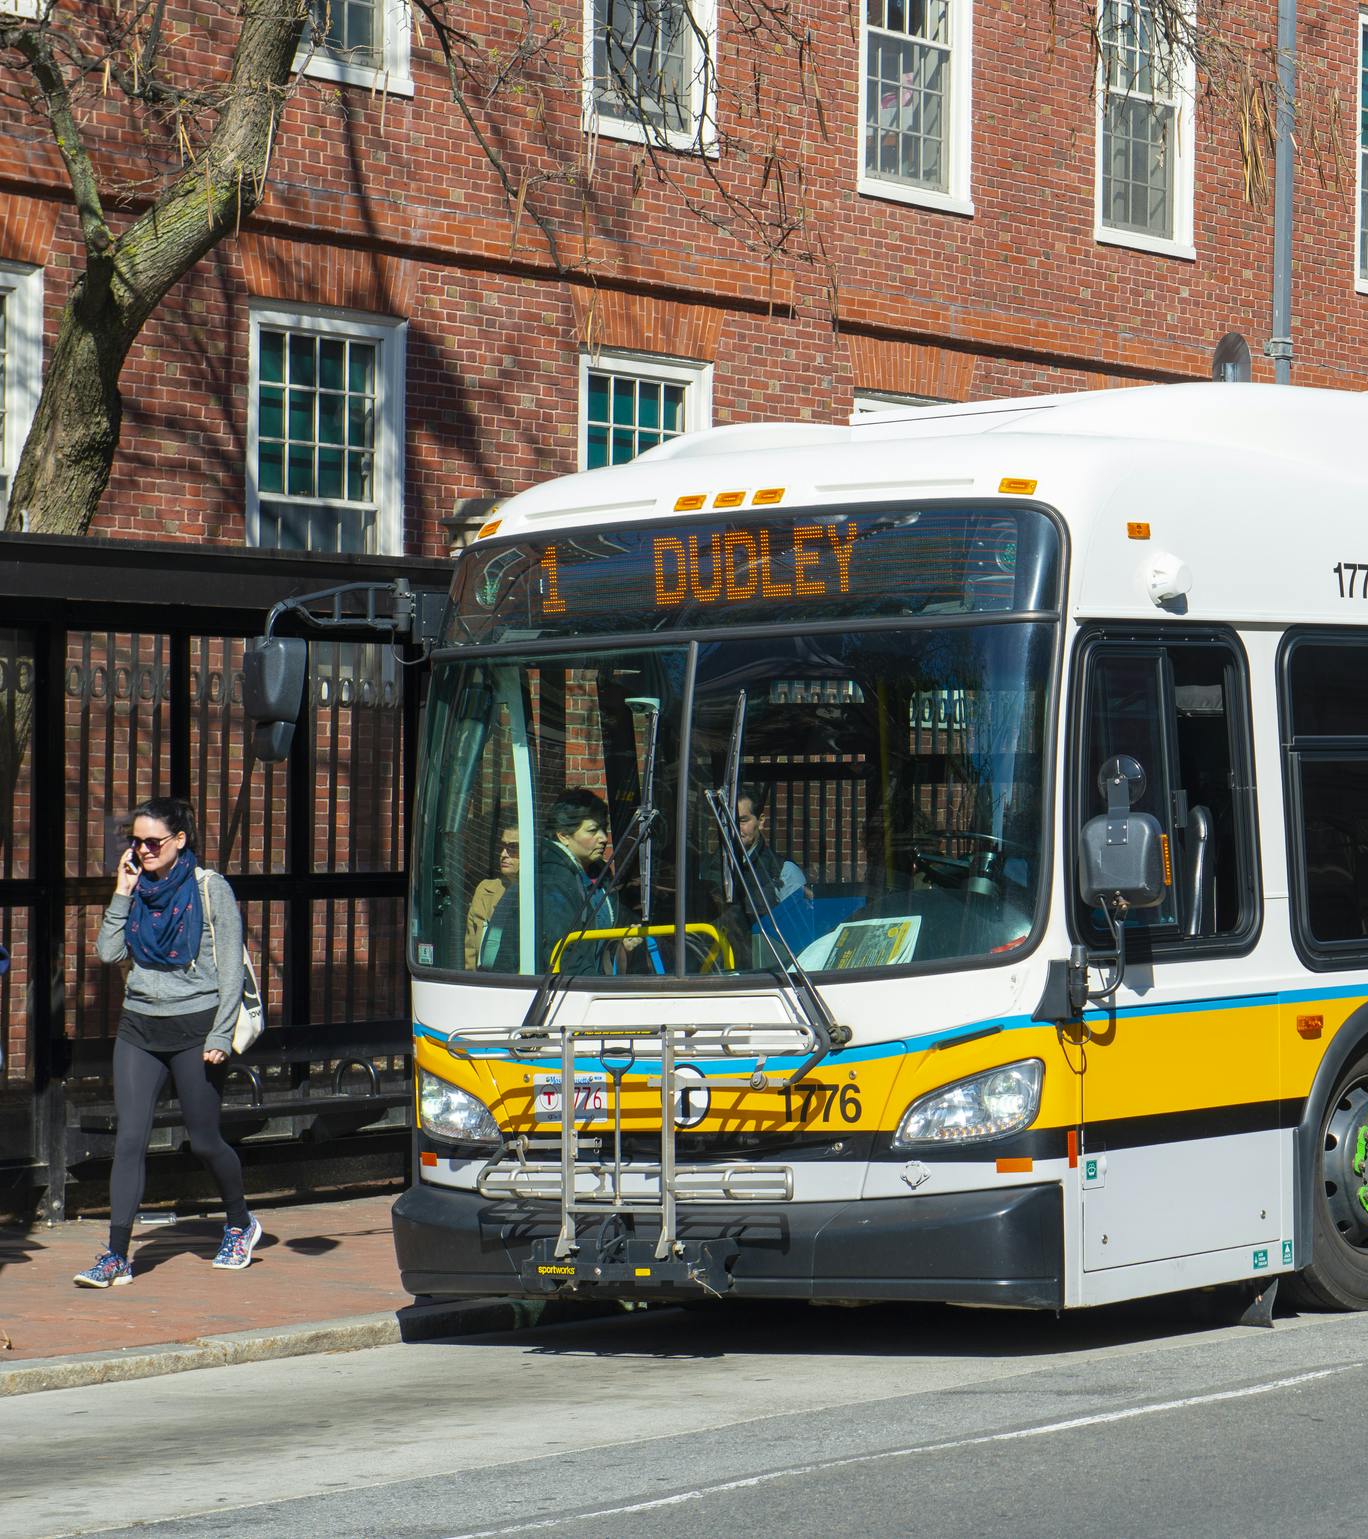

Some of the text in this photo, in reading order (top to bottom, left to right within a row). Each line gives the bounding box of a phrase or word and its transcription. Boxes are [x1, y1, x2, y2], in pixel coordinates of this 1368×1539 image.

[541, 522, 857, 612] 1 DUDLEY
[574, 1086, 602, 1111] 776
[777, 1083, 862, 1123] 1776
[538, 1265, 576, 1275] sportworks
